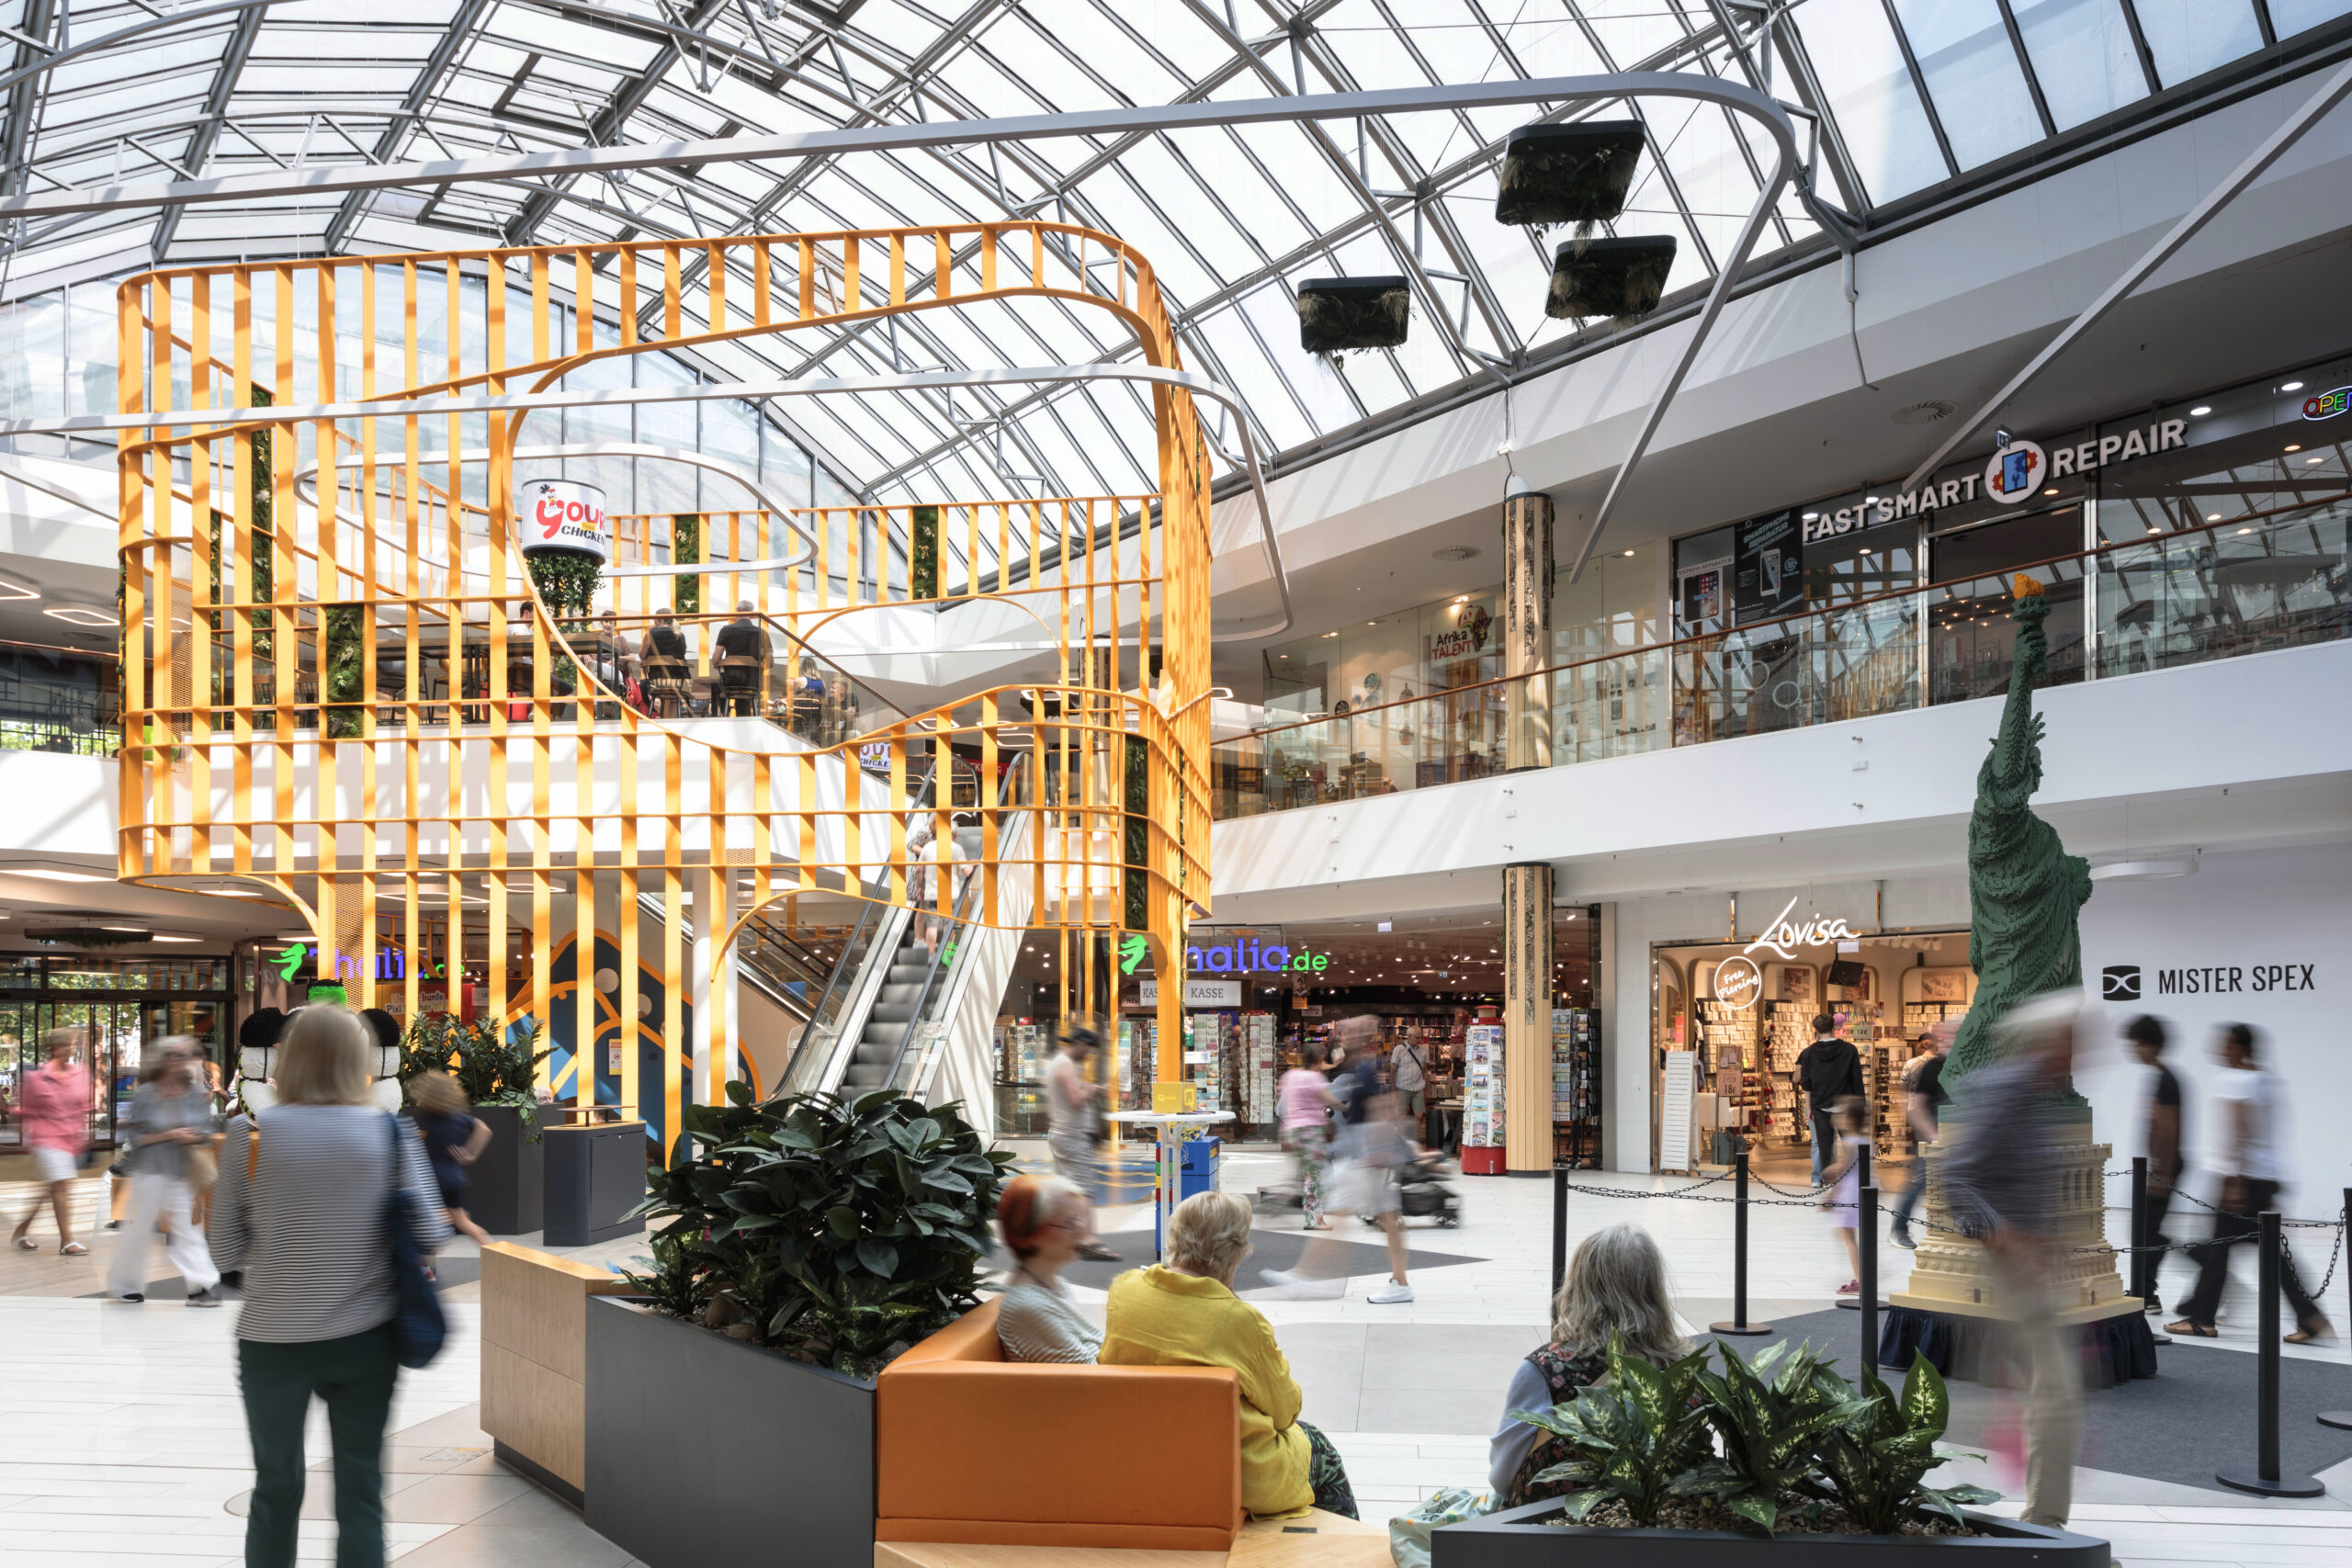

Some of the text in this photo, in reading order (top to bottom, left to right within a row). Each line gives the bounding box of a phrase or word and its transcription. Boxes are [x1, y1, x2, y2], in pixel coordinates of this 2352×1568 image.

[1802, 418, 2188, 542] FAST SMART REPAIR
[560, 525, 605, 546] CHICKEN
[1436, 630, 1467, 647] Afrika
[1431, 640, 1472, 660] TALENT
[1744, 896, 1862, 960] Lovisa
[1719, 975, 1758, 998] Piercing
[1724, 970, 1745, 984] Free
[2158, 964, 2315, 994] MISTER SPEX
[1191, 987, 1224, 998] KASSE
